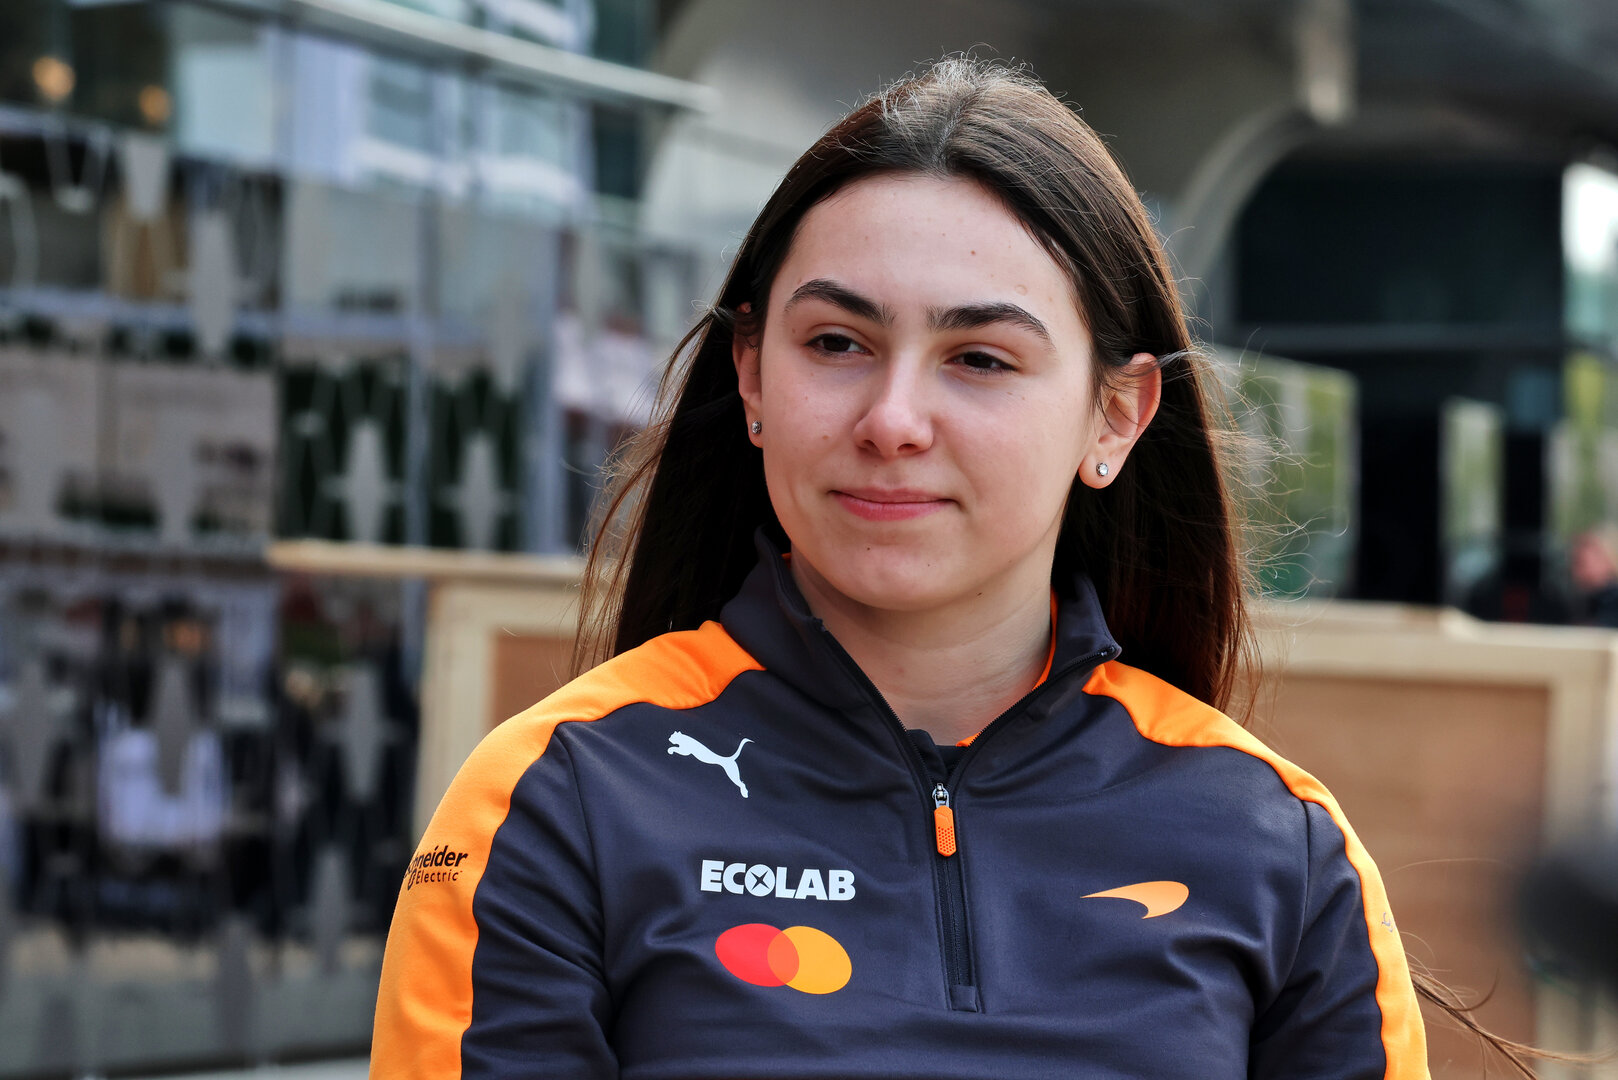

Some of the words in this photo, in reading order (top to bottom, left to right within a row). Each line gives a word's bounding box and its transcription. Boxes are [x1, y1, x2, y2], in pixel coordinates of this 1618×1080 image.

[404, 845, 468, 876] neider
[415, 869, 460, 885] Electric
[700, 859, 856, 901] ECOLAB
